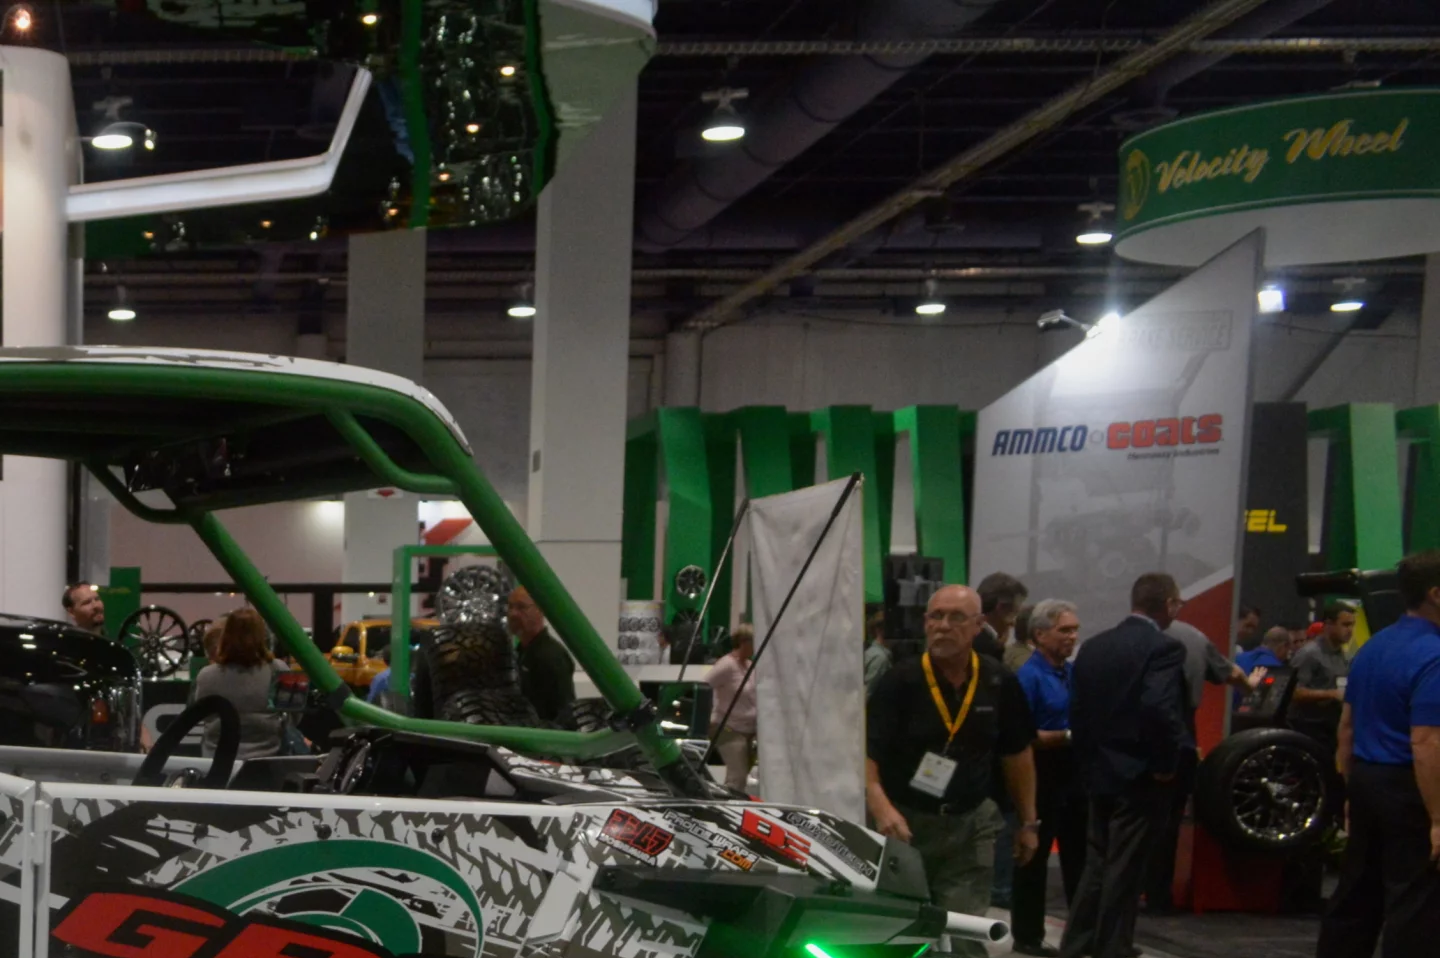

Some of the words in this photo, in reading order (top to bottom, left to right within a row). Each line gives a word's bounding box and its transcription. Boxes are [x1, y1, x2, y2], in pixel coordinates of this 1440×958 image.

[1157, 145, 1268, 193] Velocity
[1283, 118, 1409, 164] Wheel
[992, 425, 1088, 456] AMMCO
[1244, 509, 1288, 532] EL
